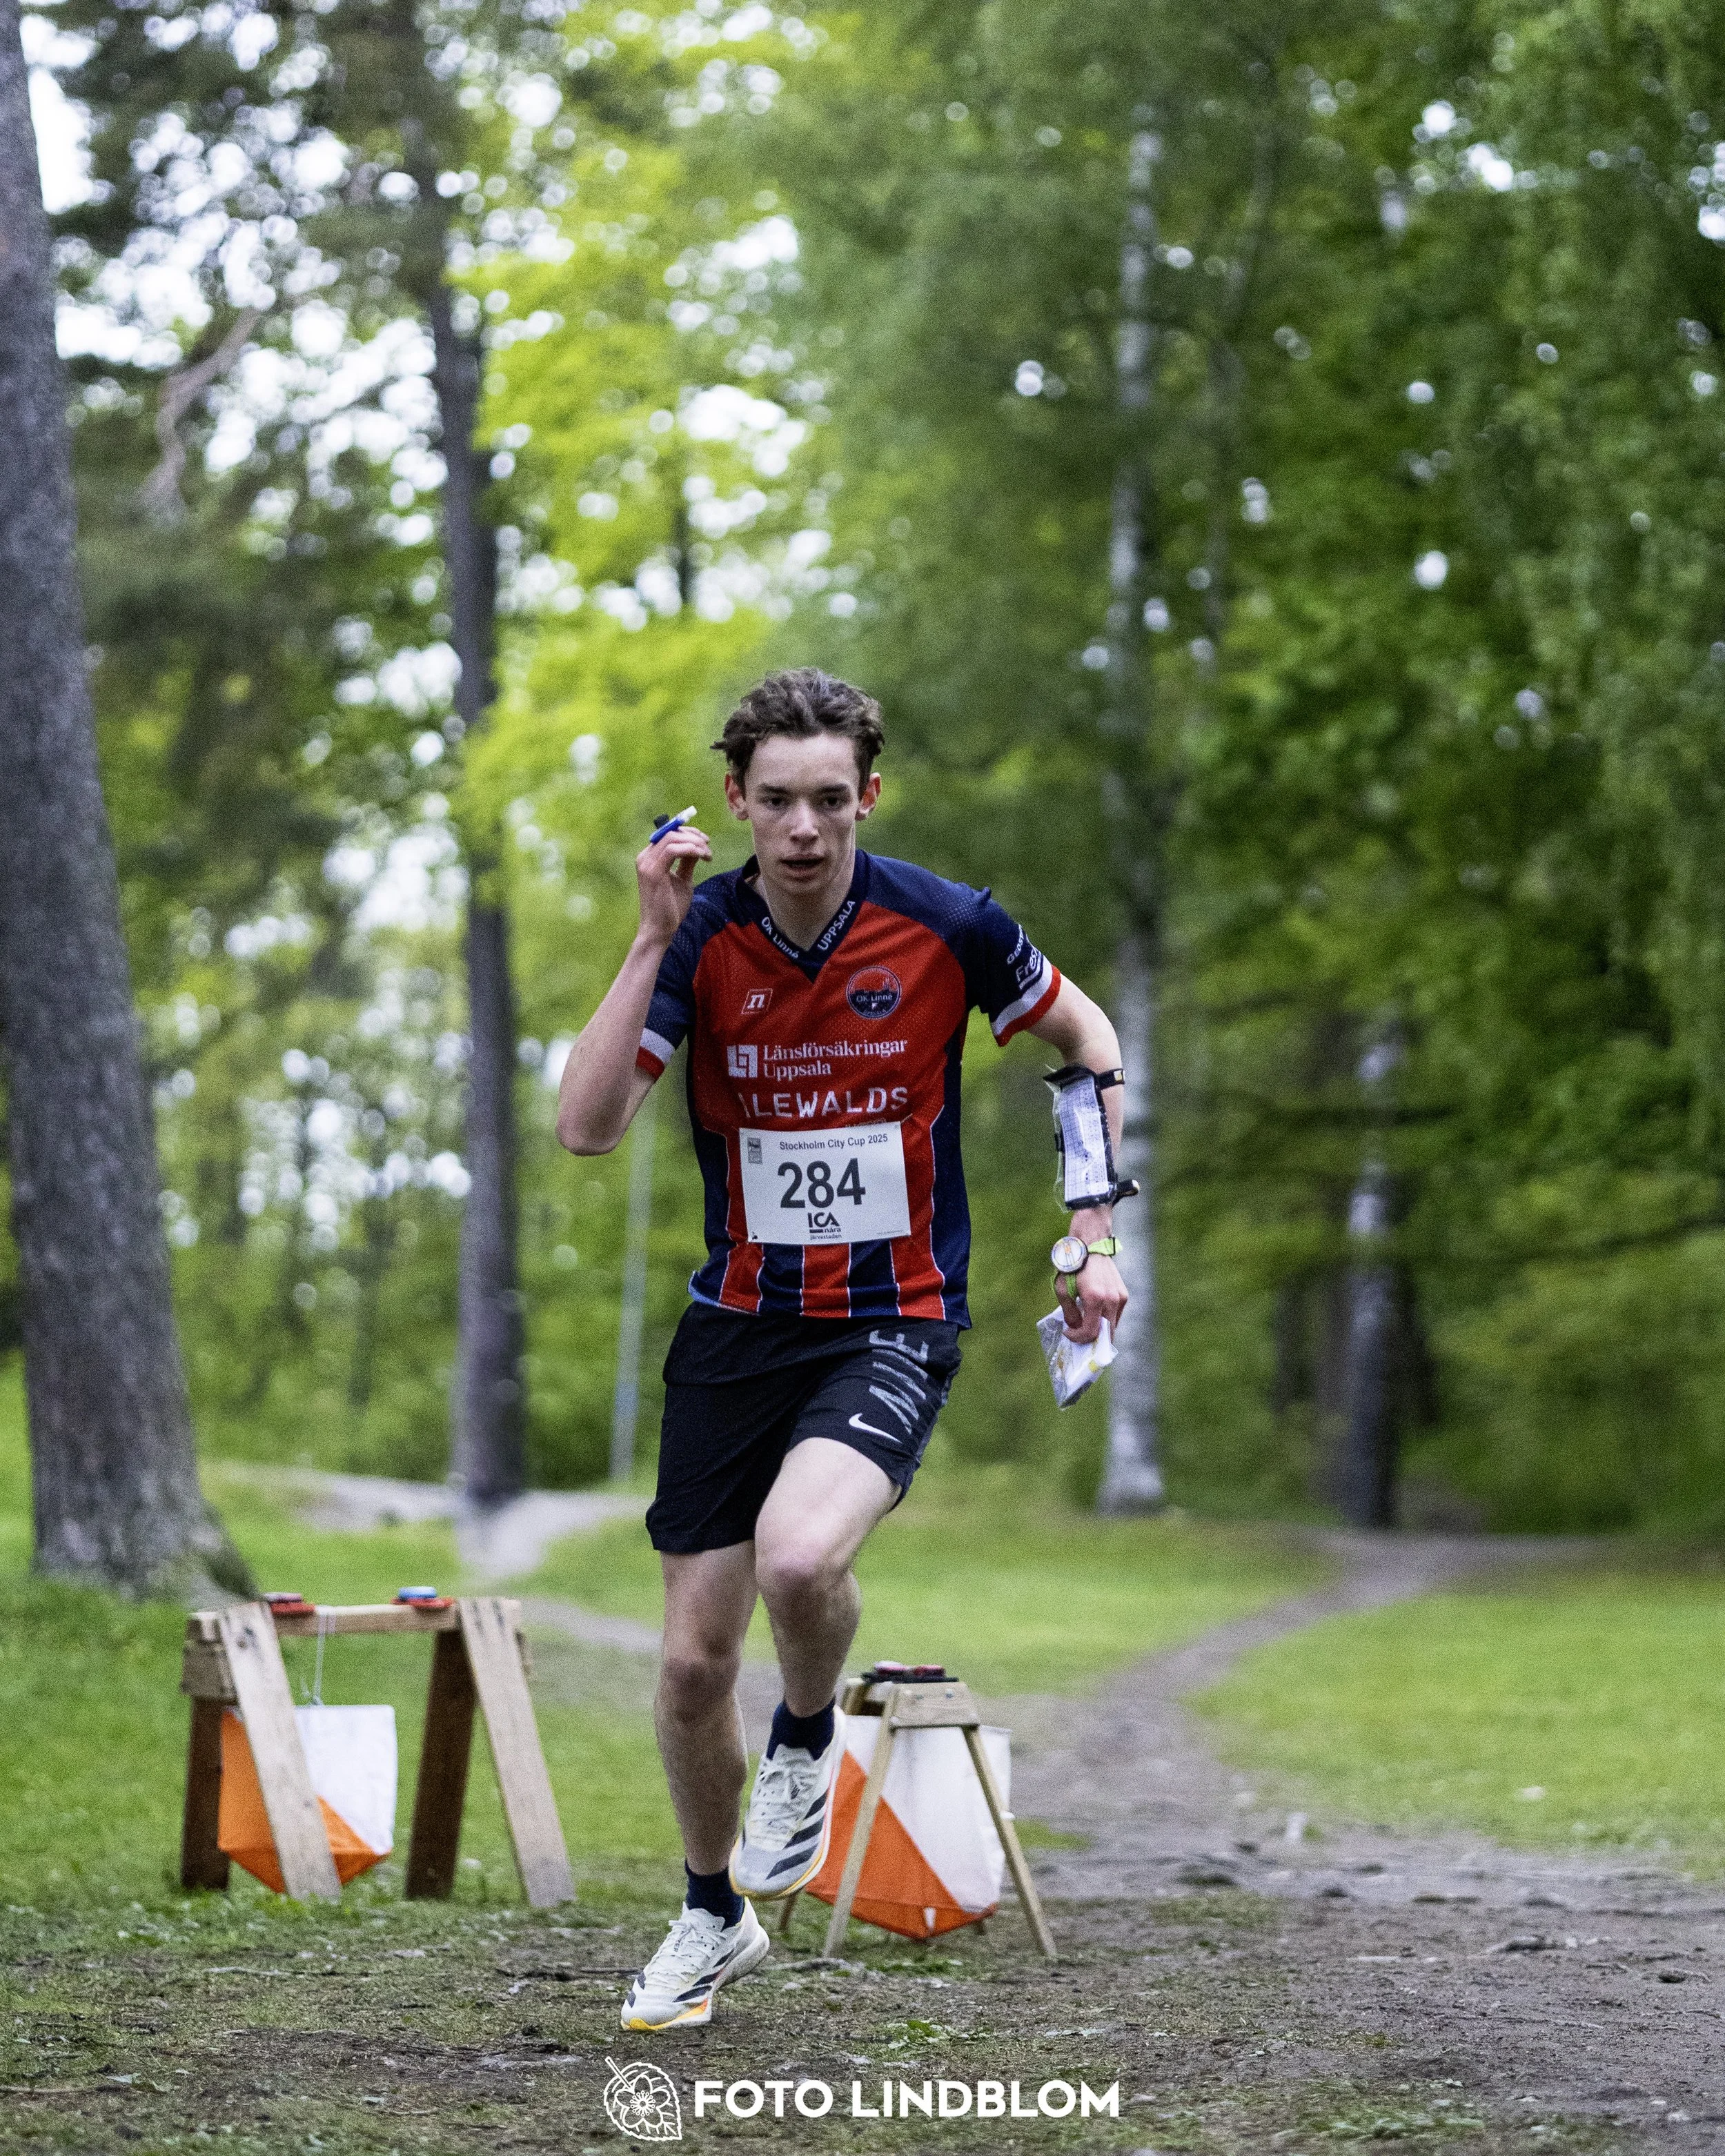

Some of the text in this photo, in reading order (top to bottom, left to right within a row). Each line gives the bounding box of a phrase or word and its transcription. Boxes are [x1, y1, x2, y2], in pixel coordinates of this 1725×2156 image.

[817, 900, 856, 951] UPPSALA
[772, 933, 799, 960] Linné
[871, 993, 893, 1002] Linné
[763, 1039, 908, 1061] Länsförsäkringar
[764, 1060, 832, 1081] Uppsala
[780, 1134, 888, 1150] Stockholm City Cup 2025
[777, 1158, 866, 1209] 284
[808, 1211, 840, 1228] ICA
